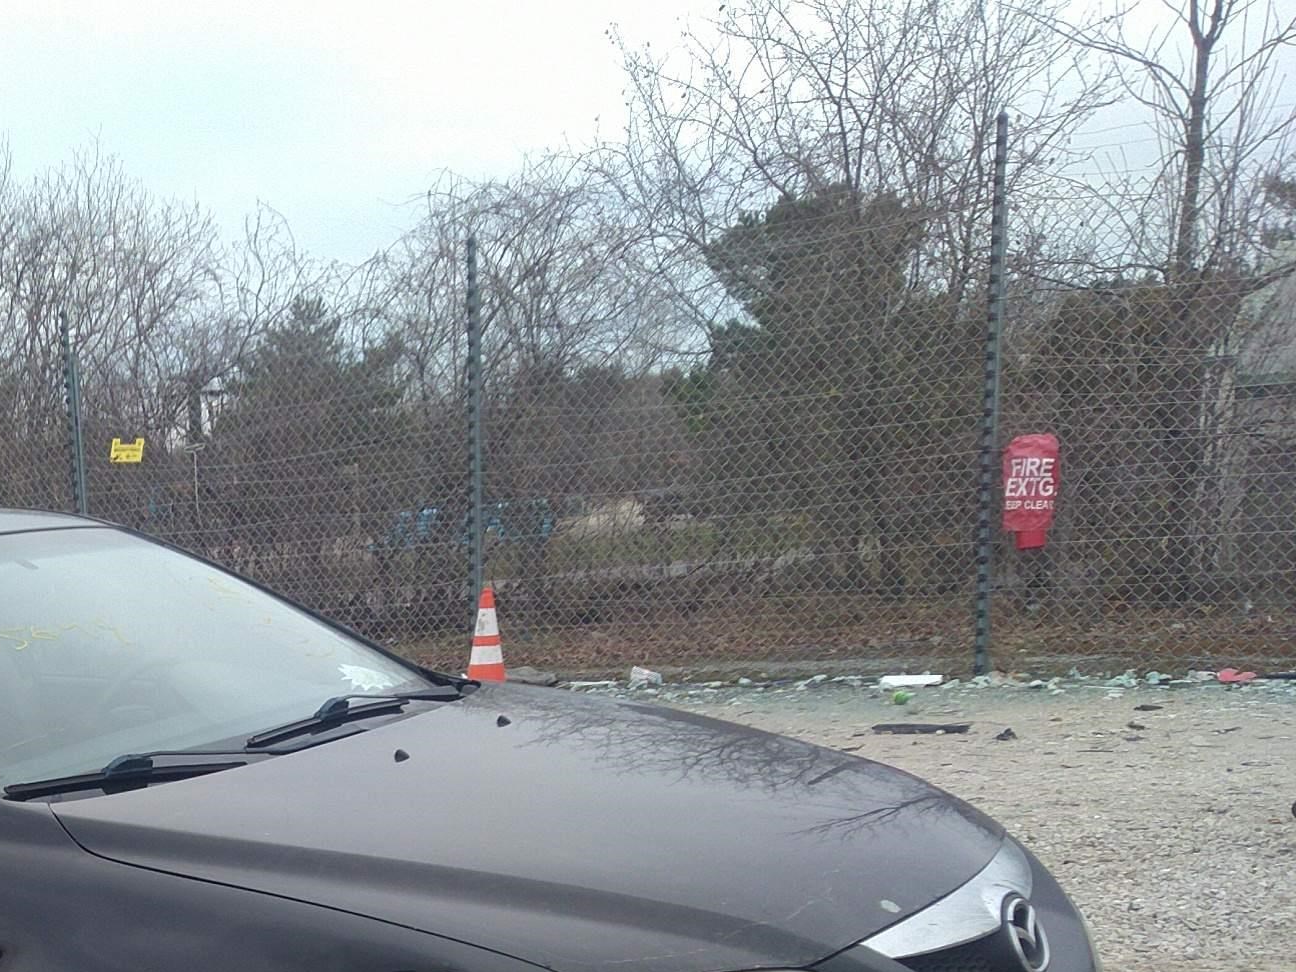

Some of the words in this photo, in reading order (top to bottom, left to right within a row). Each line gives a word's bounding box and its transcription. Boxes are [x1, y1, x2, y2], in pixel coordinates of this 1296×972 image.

[1011, 458, 1055, 477] FIRE
[1005, 477, 1058, 497] EXTG.
[1005, 500, 1022, 510] EEP
